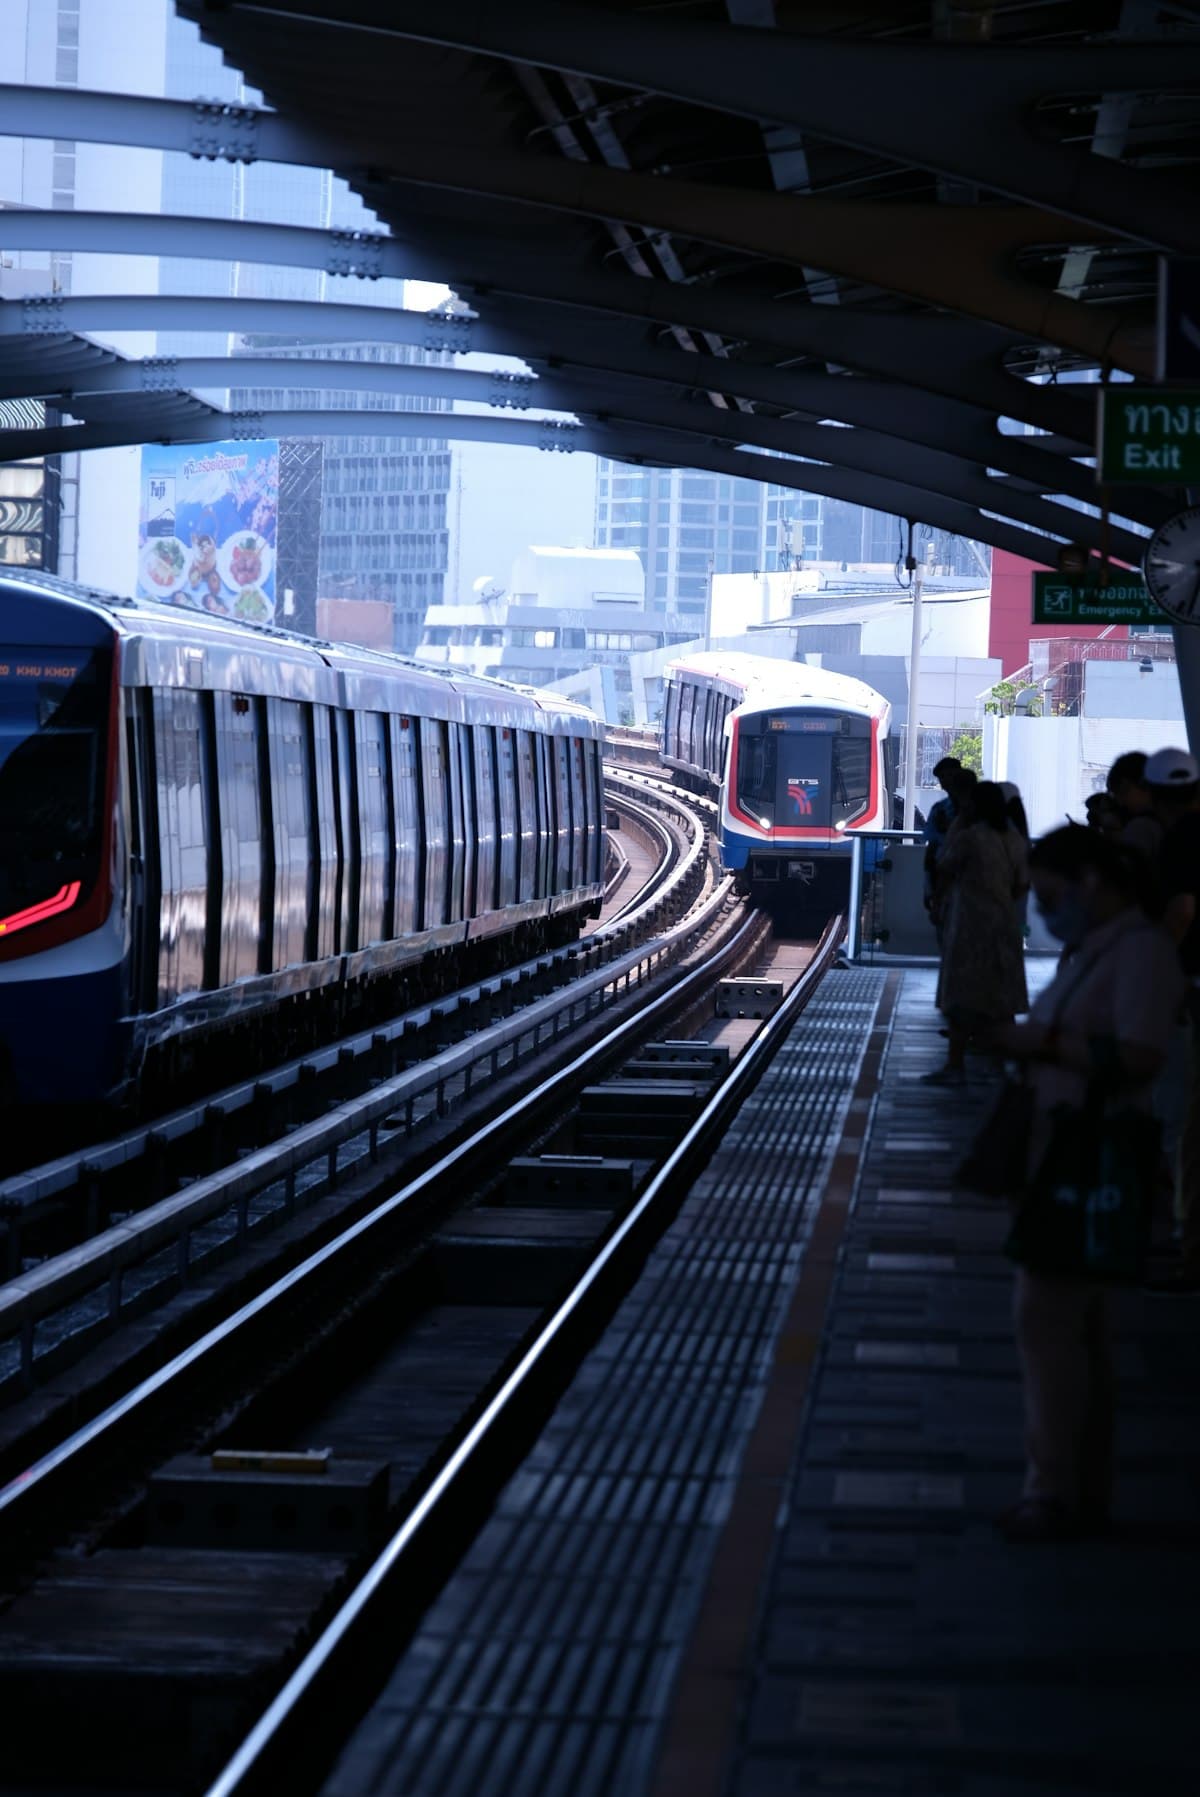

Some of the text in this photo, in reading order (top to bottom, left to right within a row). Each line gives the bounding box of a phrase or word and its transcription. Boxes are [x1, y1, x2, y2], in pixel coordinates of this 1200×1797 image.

[1124, 442, 1181, 470] Exit
[151, 480, 165, 500] Fuji
[1078, 603, 1142, 618] Emergency
[16, 665, 41, 677] KHU
[44, 666, 77, 678] KHOT
